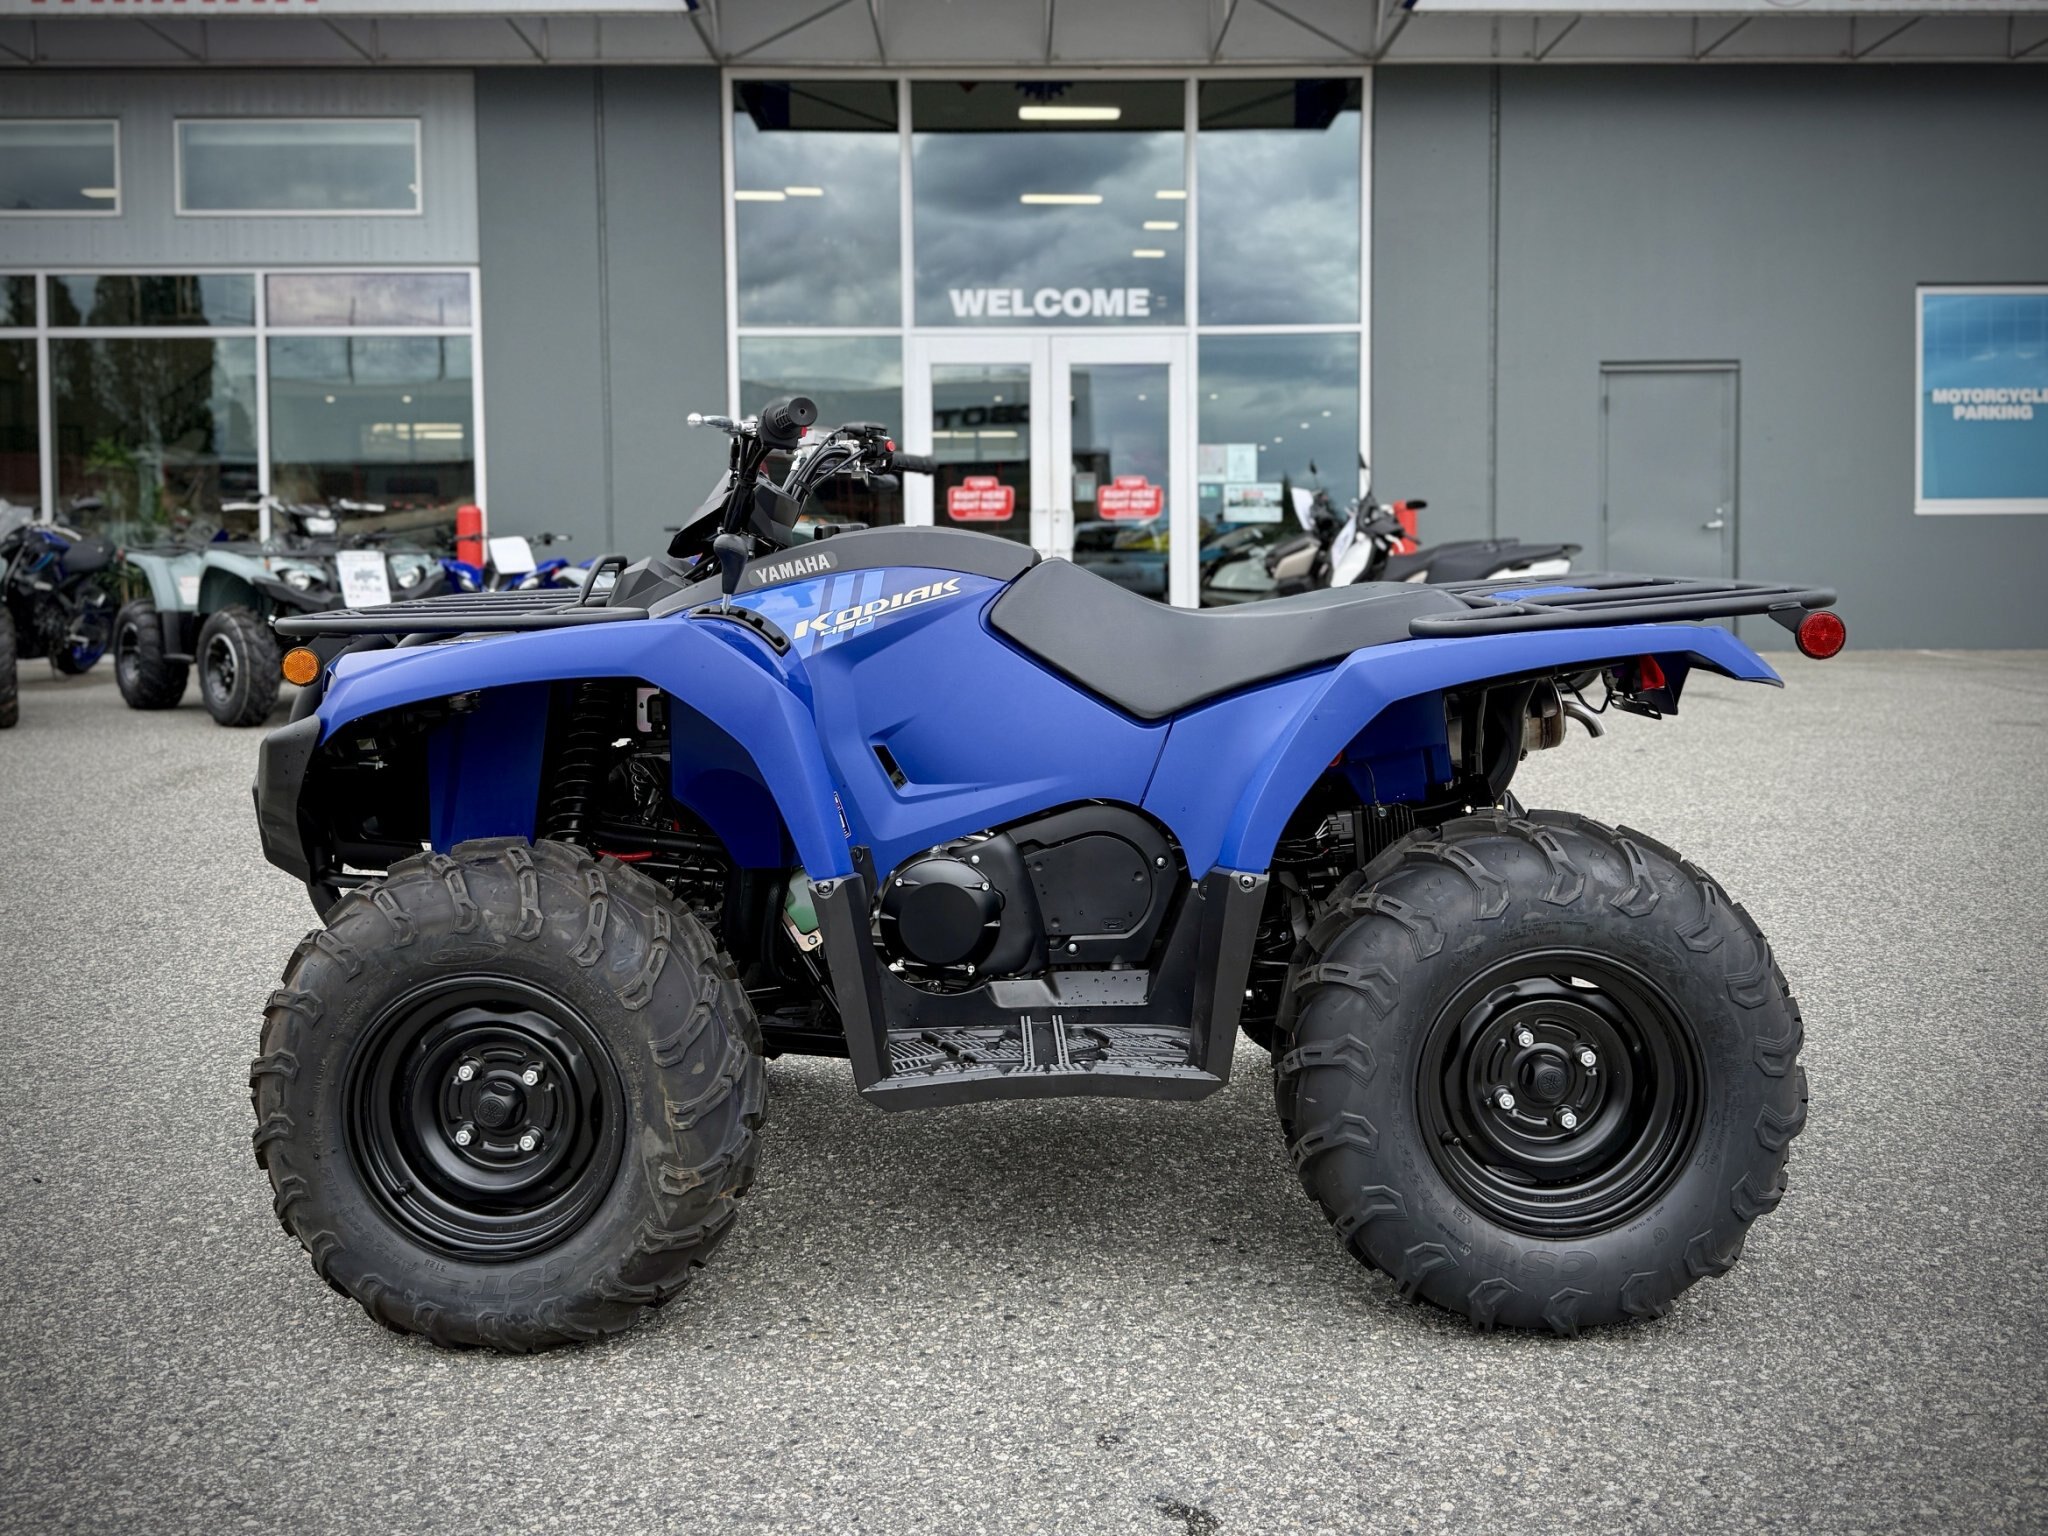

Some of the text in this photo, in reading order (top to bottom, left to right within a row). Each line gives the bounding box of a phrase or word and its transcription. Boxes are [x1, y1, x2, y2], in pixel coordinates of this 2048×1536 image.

[949, 288, 1150, 318] WELCOME
[1953, 404, 2033, 421] PARKING
[756, 554, 831, 585] YAMAHA
[793, 577, 961, 640] KODIAK
[820, 615, 874, 637] 450
